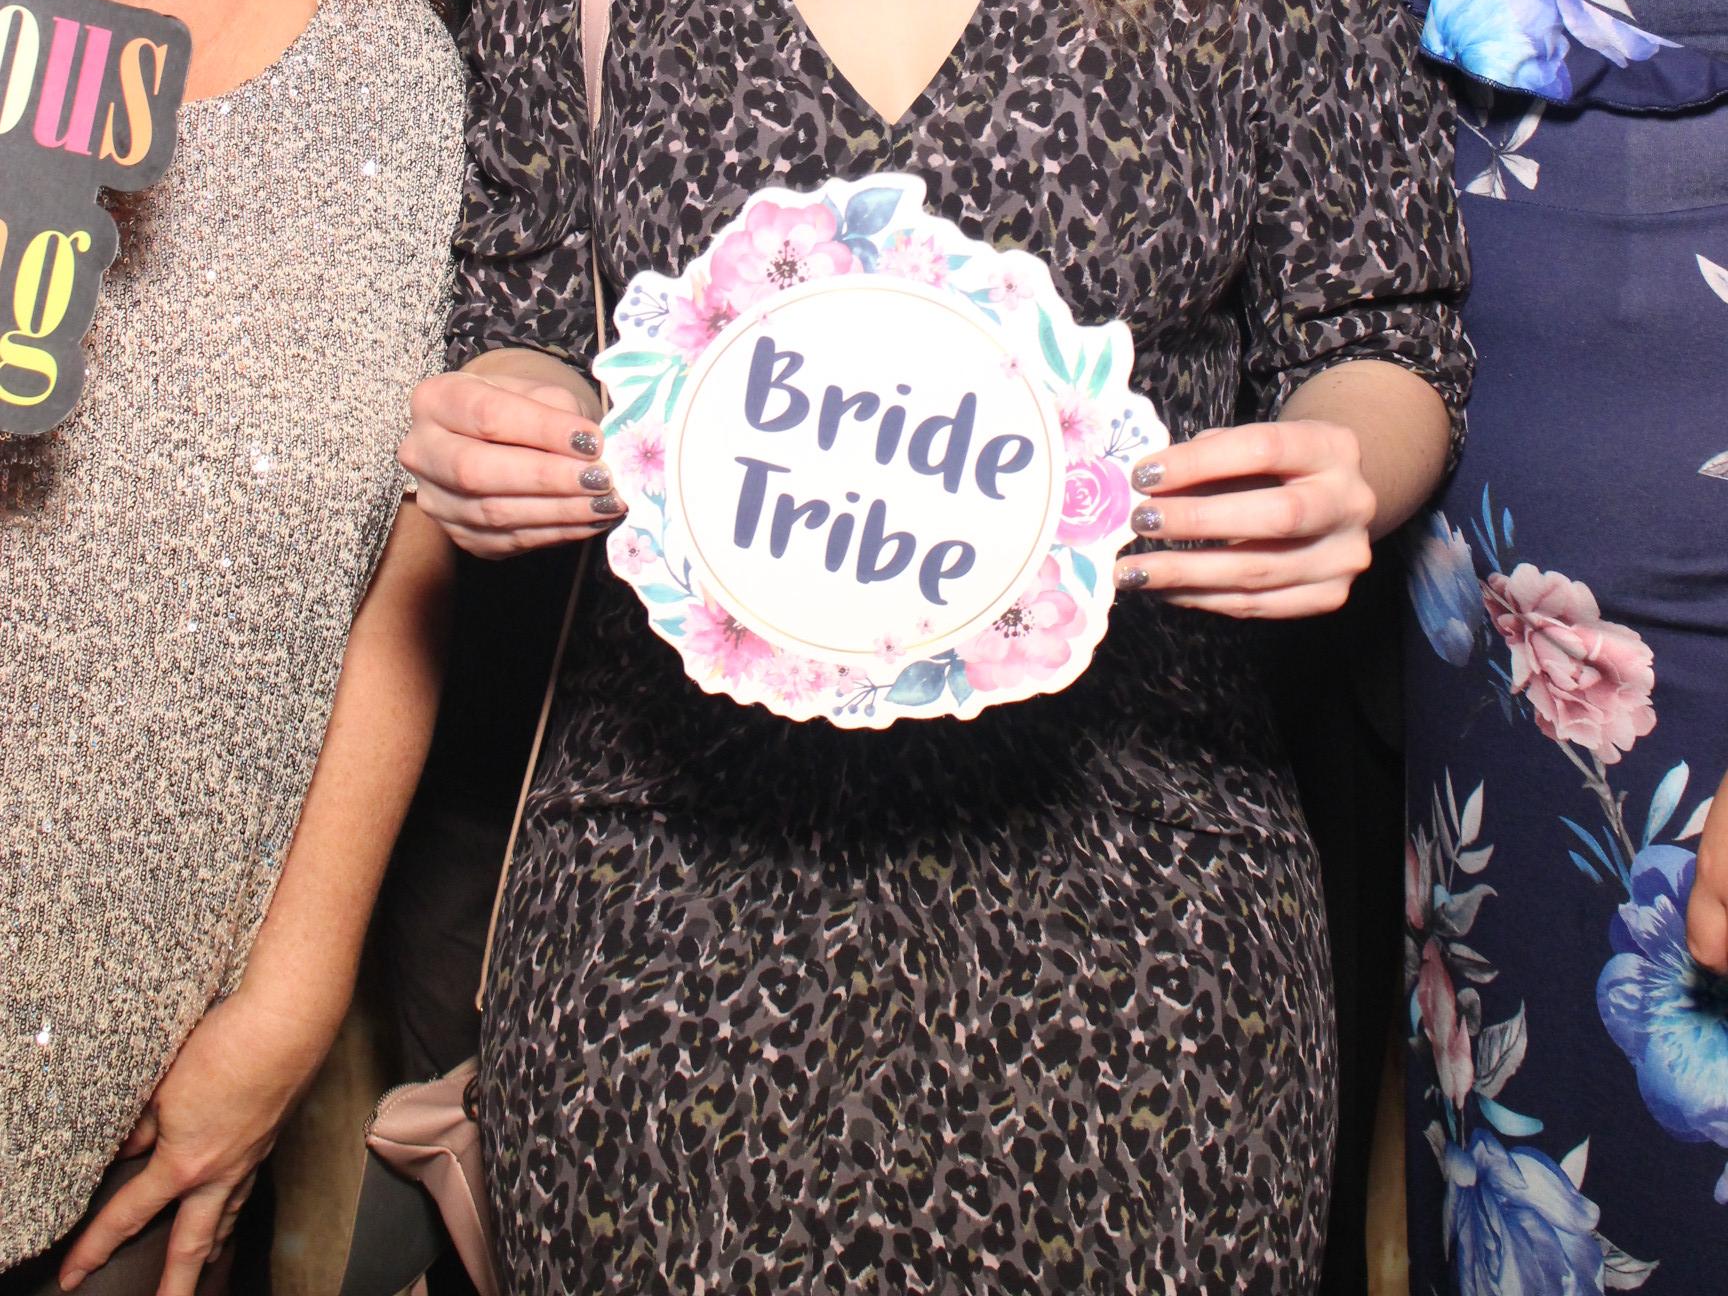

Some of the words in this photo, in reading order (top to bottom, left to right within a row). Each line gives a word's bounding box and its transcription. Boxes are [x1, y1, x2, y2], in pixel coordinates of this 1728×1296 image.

[0, 217, 92, 407] g
[744, 335, 1035, 501] Bride
[733, 455, 977, 607] Tribe
